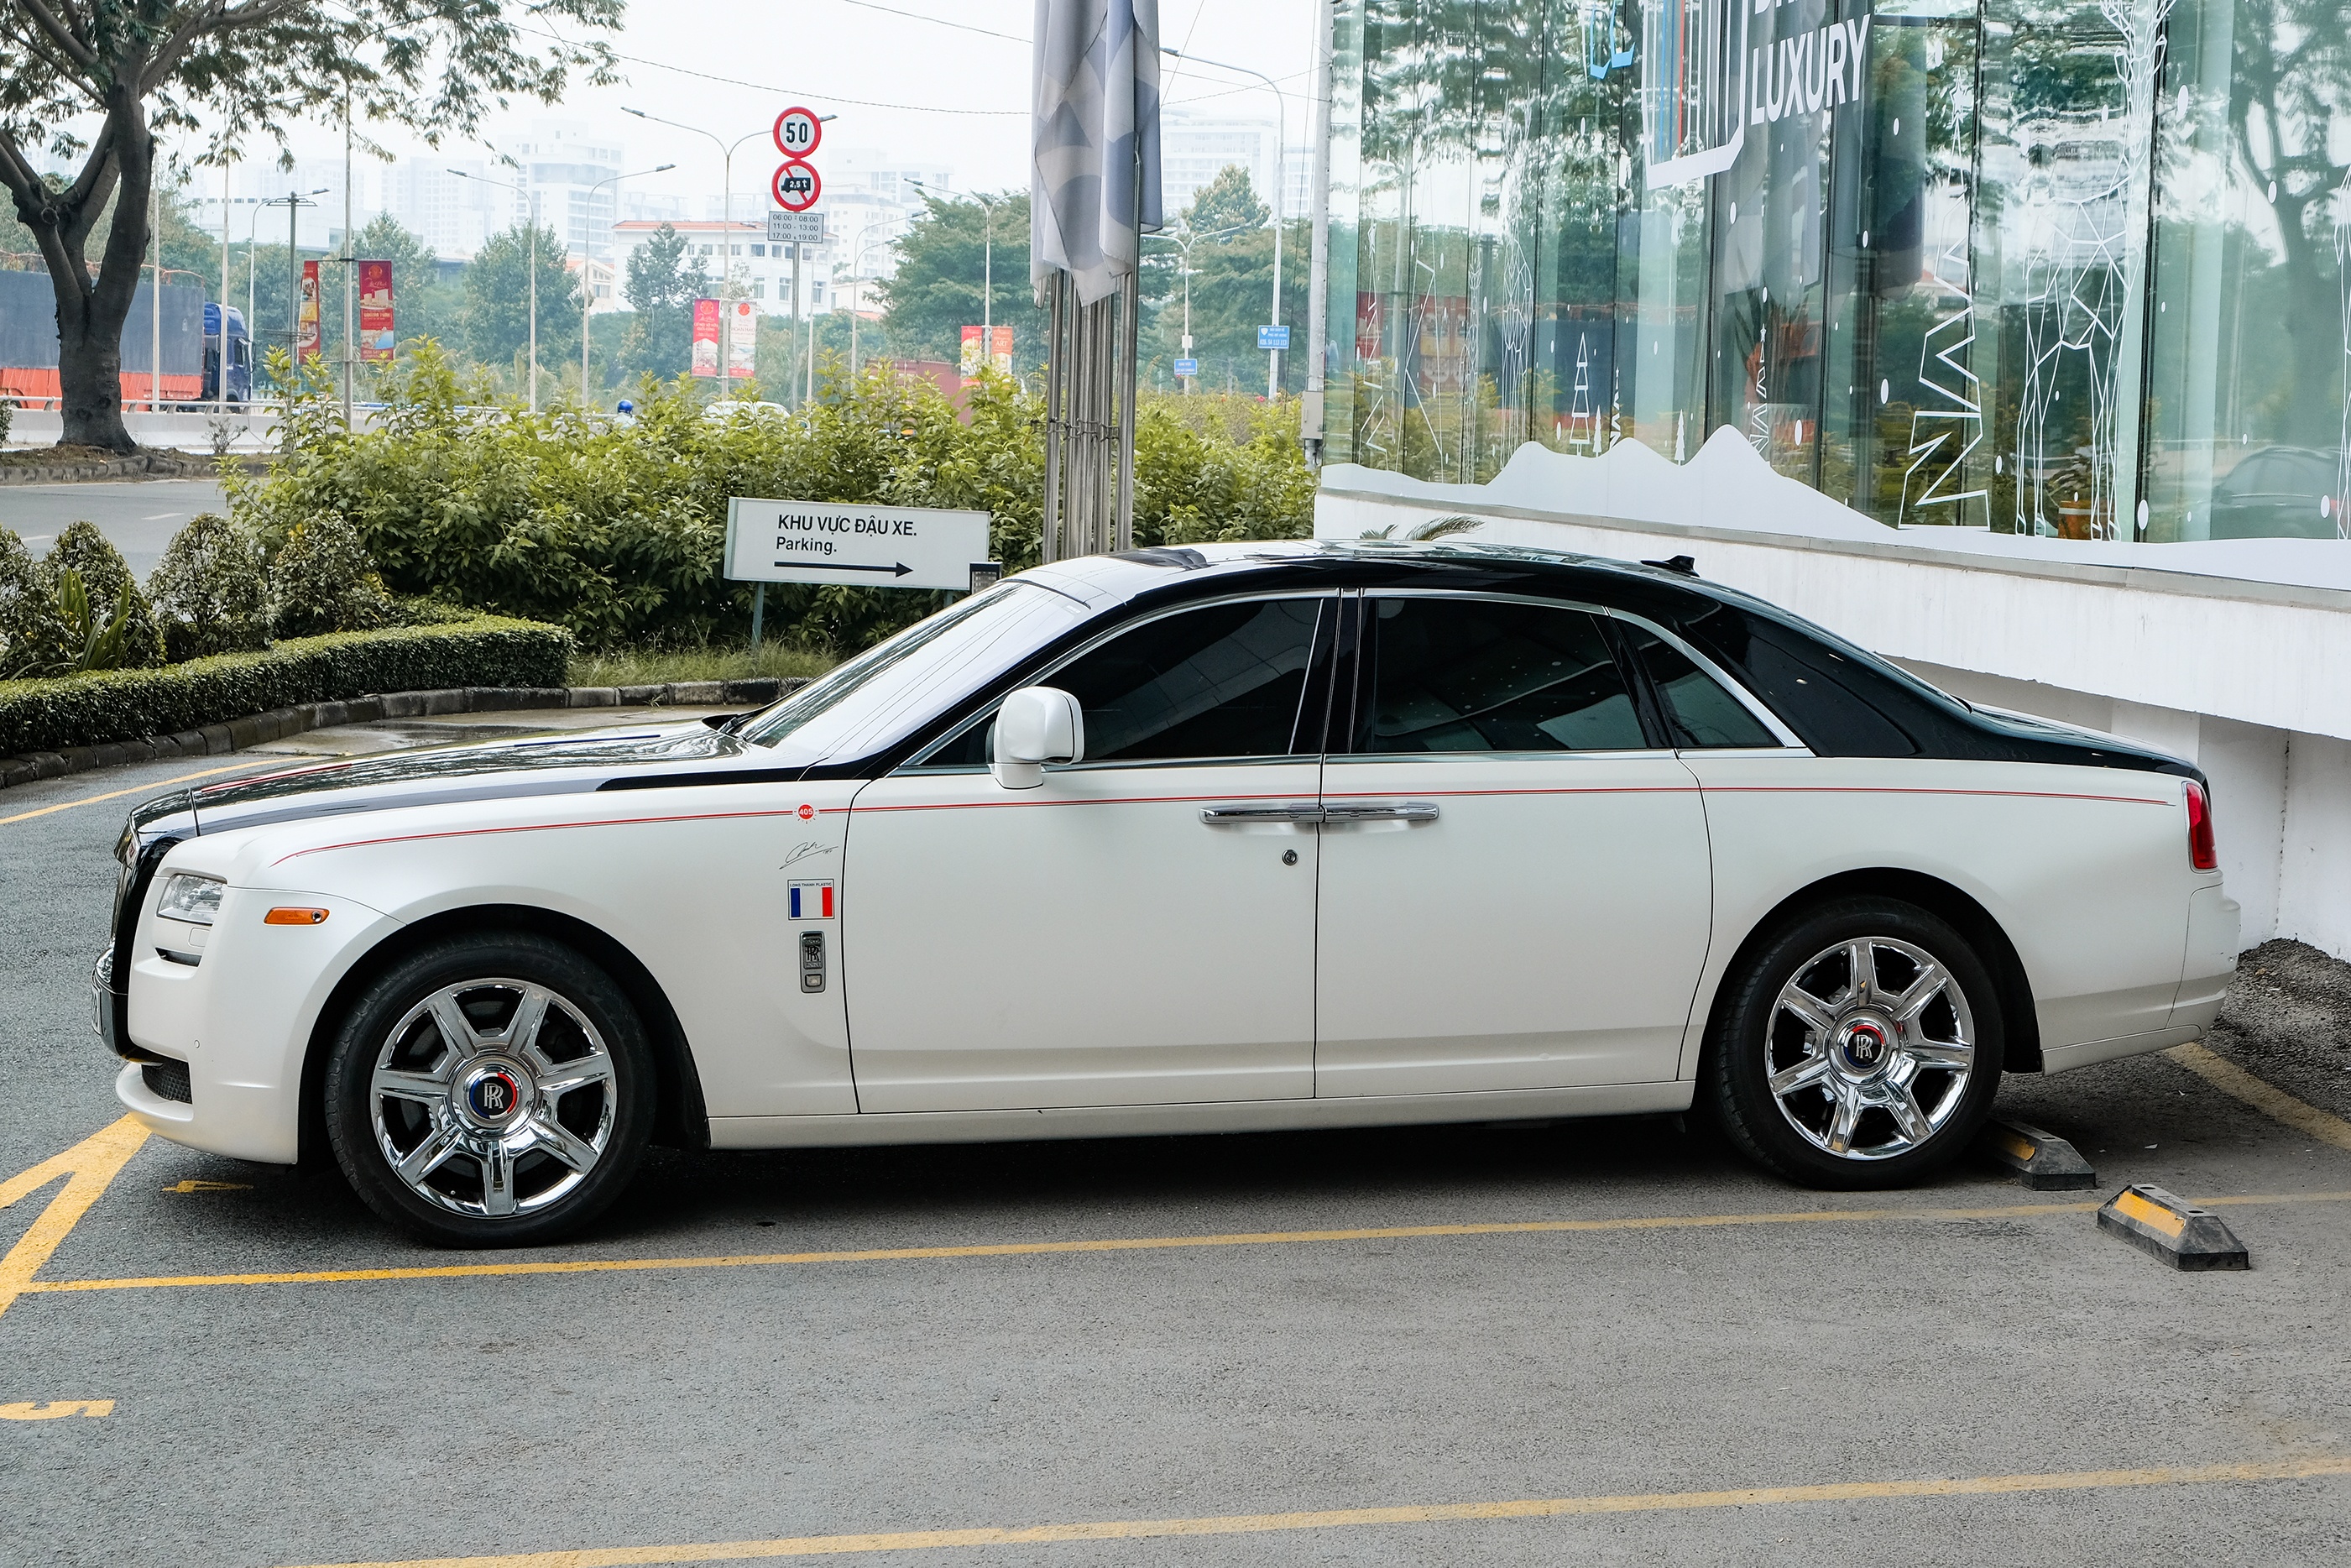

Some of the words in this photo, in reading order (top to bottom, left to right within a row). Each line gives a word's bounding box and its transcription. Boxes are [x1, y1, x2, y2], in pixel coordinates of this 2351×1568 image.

[1751, 13, 1871, 125] LUXURY
[786, 122, 807, 144] 50
[778, 515, 813, 531] KHU
[818, 515, 851, 536] VỰC
[854, 515, 888, 537] ĐẬU
[892, 520, 917, 536] XE.
[776, 536, 838, 555] Parking.
[1856, 1034, 1873, 1058] RR
[483, 1082, 504, 1110] RR
